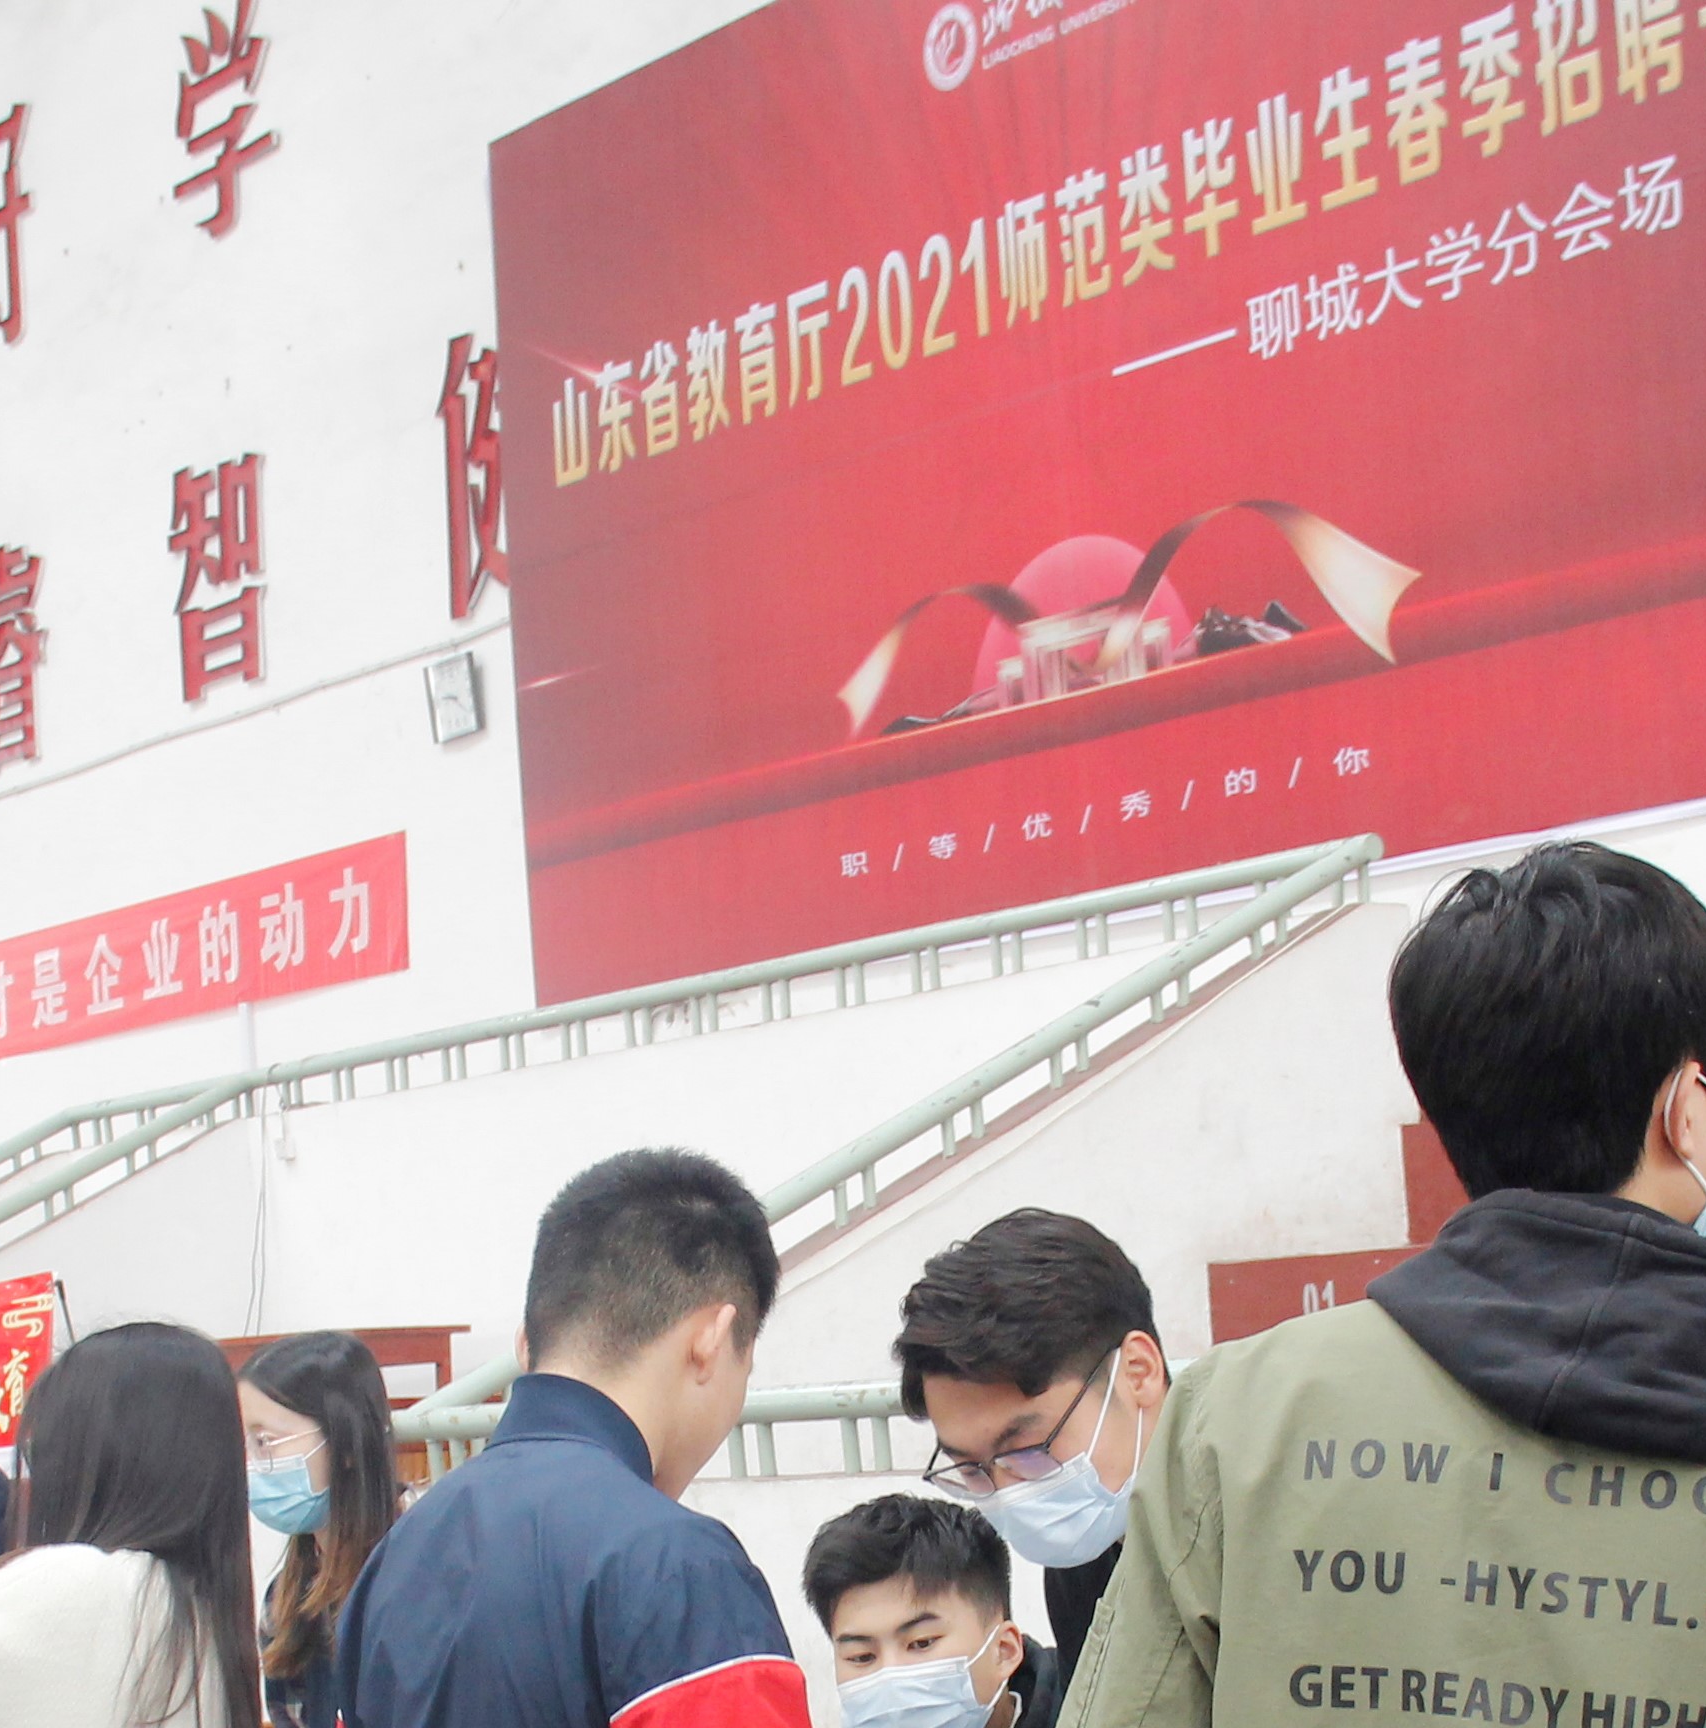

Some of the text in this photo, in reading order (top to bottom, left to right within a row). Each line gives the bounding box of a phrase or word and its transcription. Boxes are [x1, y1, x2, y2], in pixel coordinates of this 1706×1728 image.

[1303, 1439, 1450, 1484] NOW
[1488, 1451, 1504, 1492] I
[1293, 1549, 1407, 1595] YOU
